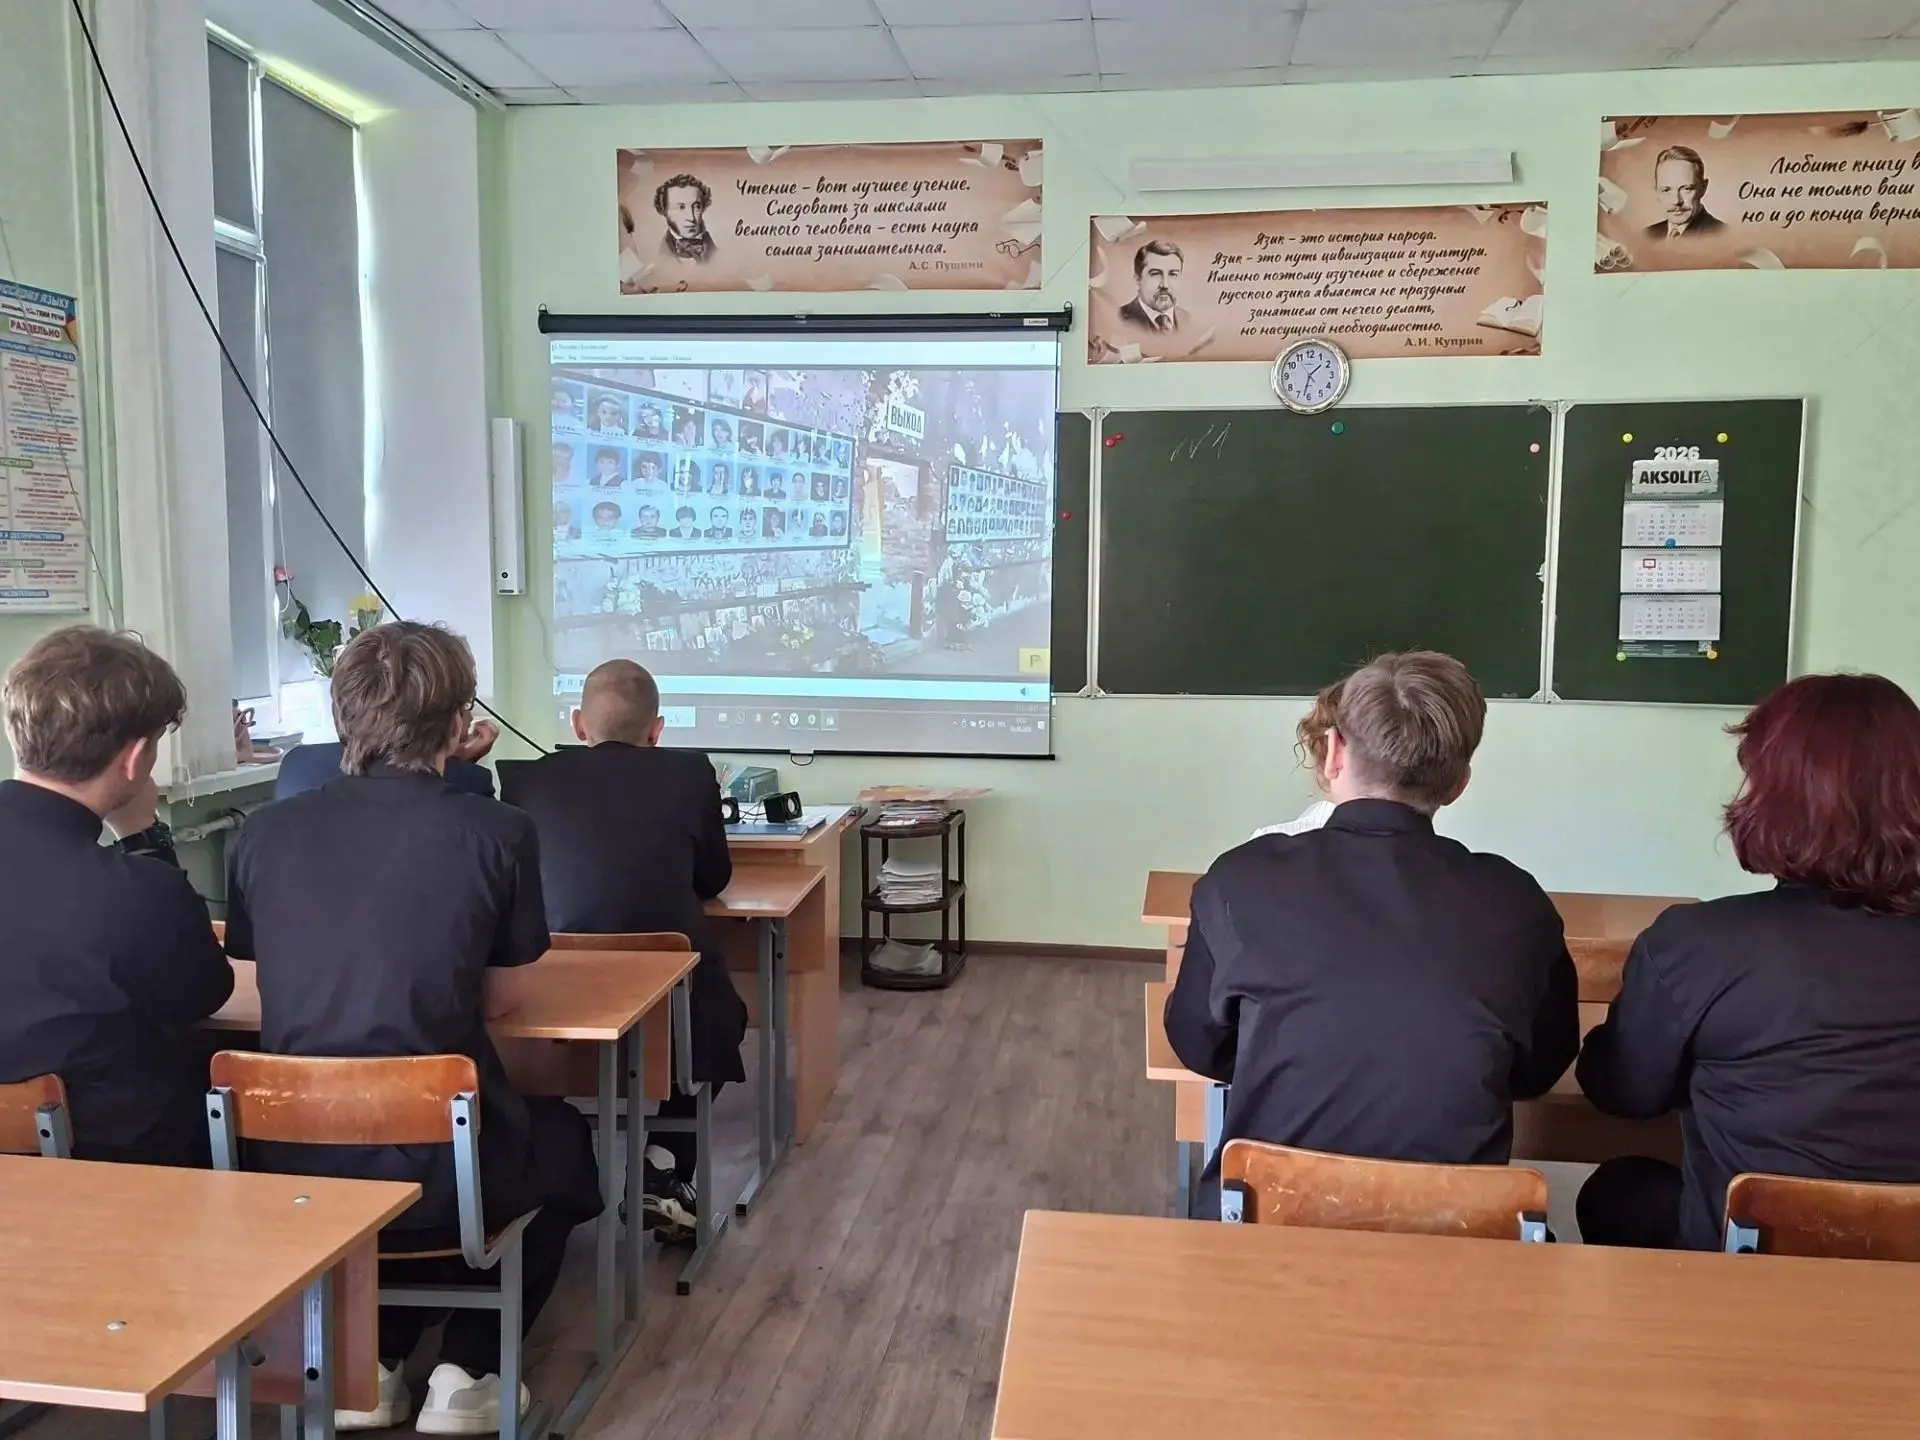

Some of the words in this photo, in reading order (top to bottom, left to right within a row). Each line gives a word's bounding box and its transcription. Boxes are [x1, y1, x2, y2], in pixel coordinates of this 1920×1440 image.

[1770, 153, 1848, 174] Любите
[1852, 159, 1907, 178] книгу
[736, 179, 797, 195] Чтение
[816, 176, 847, 193] вот
[852, 180, 908, 199] лучшее
[910, 179, 970, 198] учение.
[1739, 181, 1776, 200] Она
[1781, 185, 1803, 197] не
[1808, 184, 1872, 197] только
[1878, 176, 1915, 196] ваш
[766, 197, 848, 221] Следовать
[849, 202, 869, 221] за
[735, 219, 800, 236] великого
[806, 217, 871, 235] человека
[891, 223, 927, 234] есть
[932, 221, 979, 239] наука
[1741, 211, 1765, 223] но
[1770, 210, 1781, 221] и
[1781, 209, 1805, 229] до
[1810, 209, 1863, 224] конца
[1253, 232, 1285, 250] Язык
[1299, 234, 1325, 244] это
[1328, 232, 1384, 246] история
[1387, 231, 1437, 246] народа.
[765, 245, 812, 256] самая
[813, 243, 947, 263] занимательная.
[1211, 251, 1243, 269] Язык
[1256, 254, 1281, 263] это
[1284, 253, 1318, 267] путь
[1321, 246, 1405, 265] цивилизации
[1408, 250, 1416, 258] и
[935, 260, 983, 271] Пушкин
[1207, 270, 1260, 282] Именно
[1263, 271, 1322, 285] поэтому
[1326, 269, 1384, 284] изучение
[1387, 269, 1396, 277] и
[1400, 262, 1480, 281] сбережение
[40, 294, 69, 308] ЯЗЫКУ
[1217, 290, 1273, 305] русского
[1275, 289, 1311, 303] языка
[1313, 283, 1376, 298] является
[1380, 287, 1396, 296] не
[1399, 285, 1466, 300] праздным
[1247, 307, 1316, 322] занятием
[1320, 307, 1339, 316] от
[1342, 305, 1383, 315] нечего
[1384, 304, 1435, 319] делать,
[1240, 326, 1257, 336] но
[1260, 322, 1327, 340] насущной
[1328, 318, 1443, 338] необходимостью.
[1434, 337, 1483, 348] Куприн
[1296, 353, 1303, 362] 11
[1306, 350, 1315, 359] 12
[1318, 353, 1323, 361] 1
[1288, 361, 1297, 369] 10
[1325, 360, 1331, 369] 2
[1284, 372, 1289, 380] 9
[1329, 371, 1334, 379] 3
[1296, 391, 1301, 399] 7
[891, 405, 922, 433] ВЫХОД
[1654, 446, 1700, 461] 2026
[1639, 470, 1702, 484] AKSOLIT
